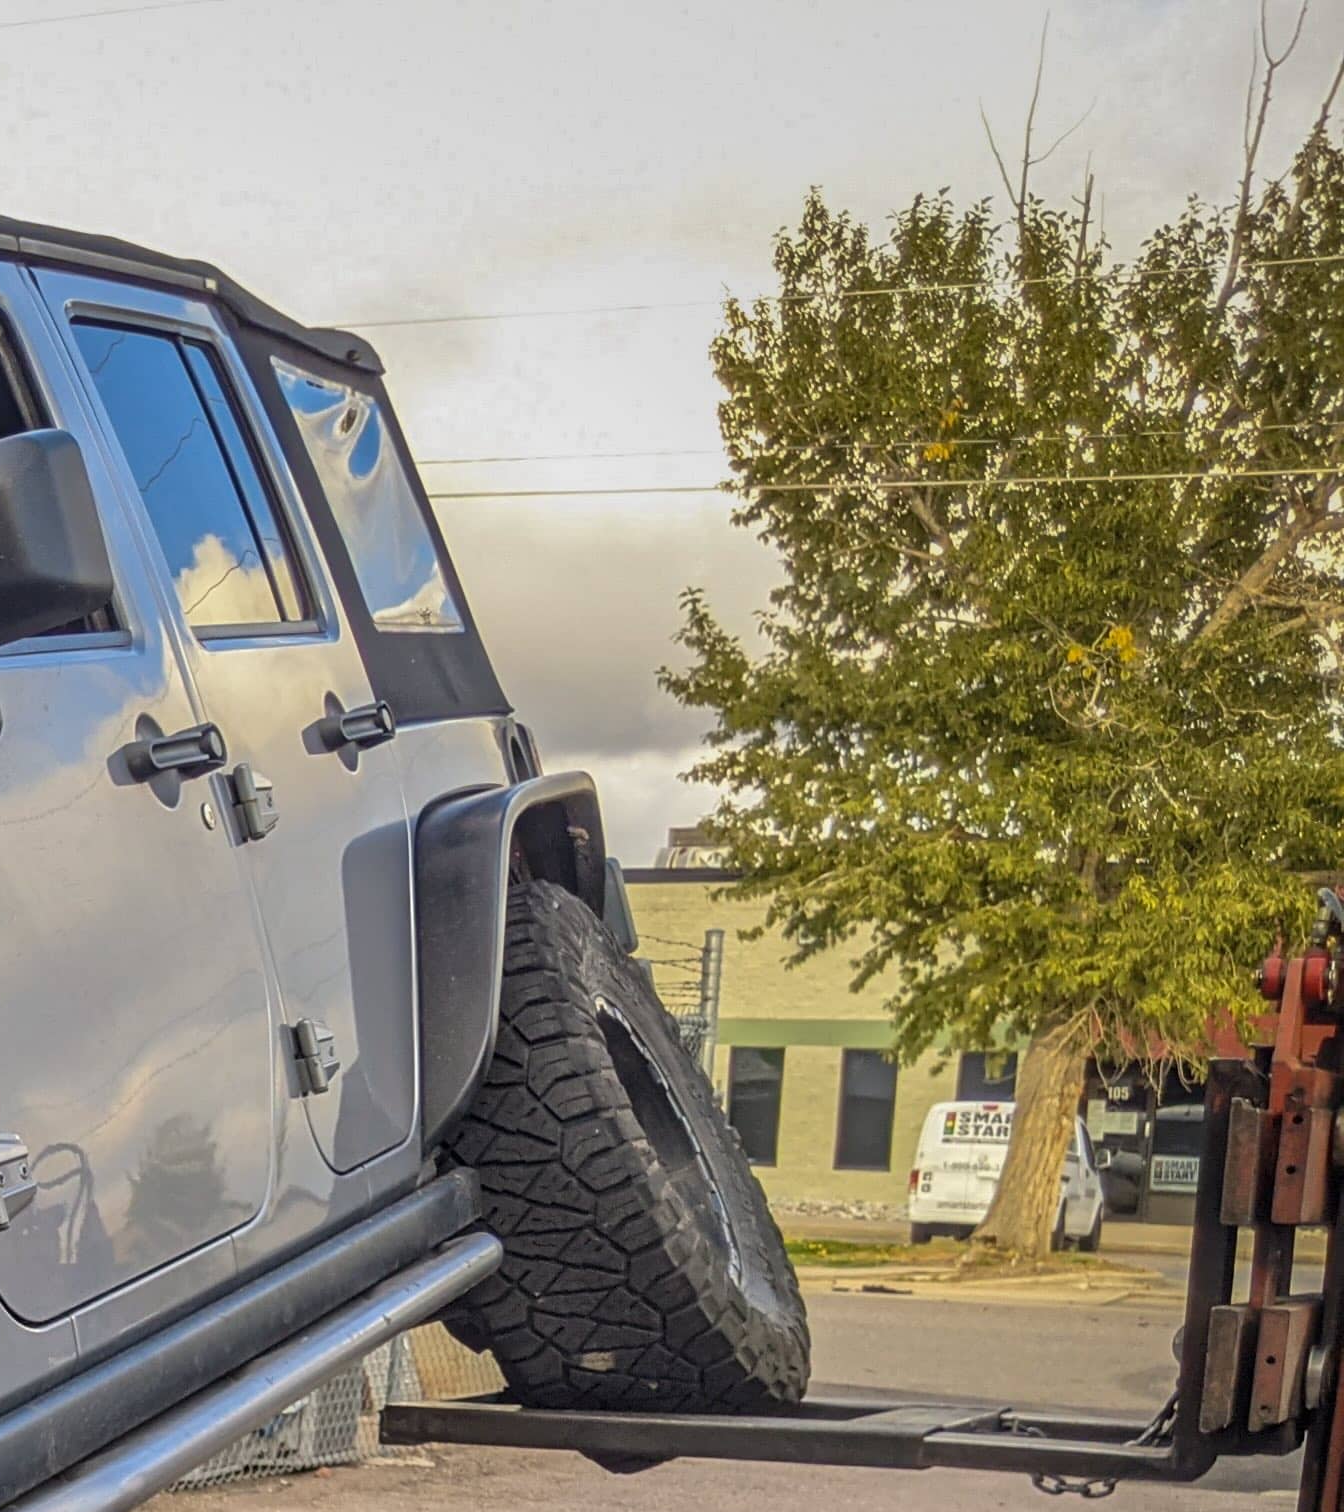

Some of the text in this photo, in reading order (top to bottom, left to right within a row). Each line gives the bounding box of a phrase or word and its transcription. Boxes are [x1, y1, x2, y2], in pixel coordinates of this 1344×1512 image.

[1107, 1085, 1129, 1100] 105
[959, 1111, 1012, 1125] SMA
[957, 1123, 1009, 1138] STAR
